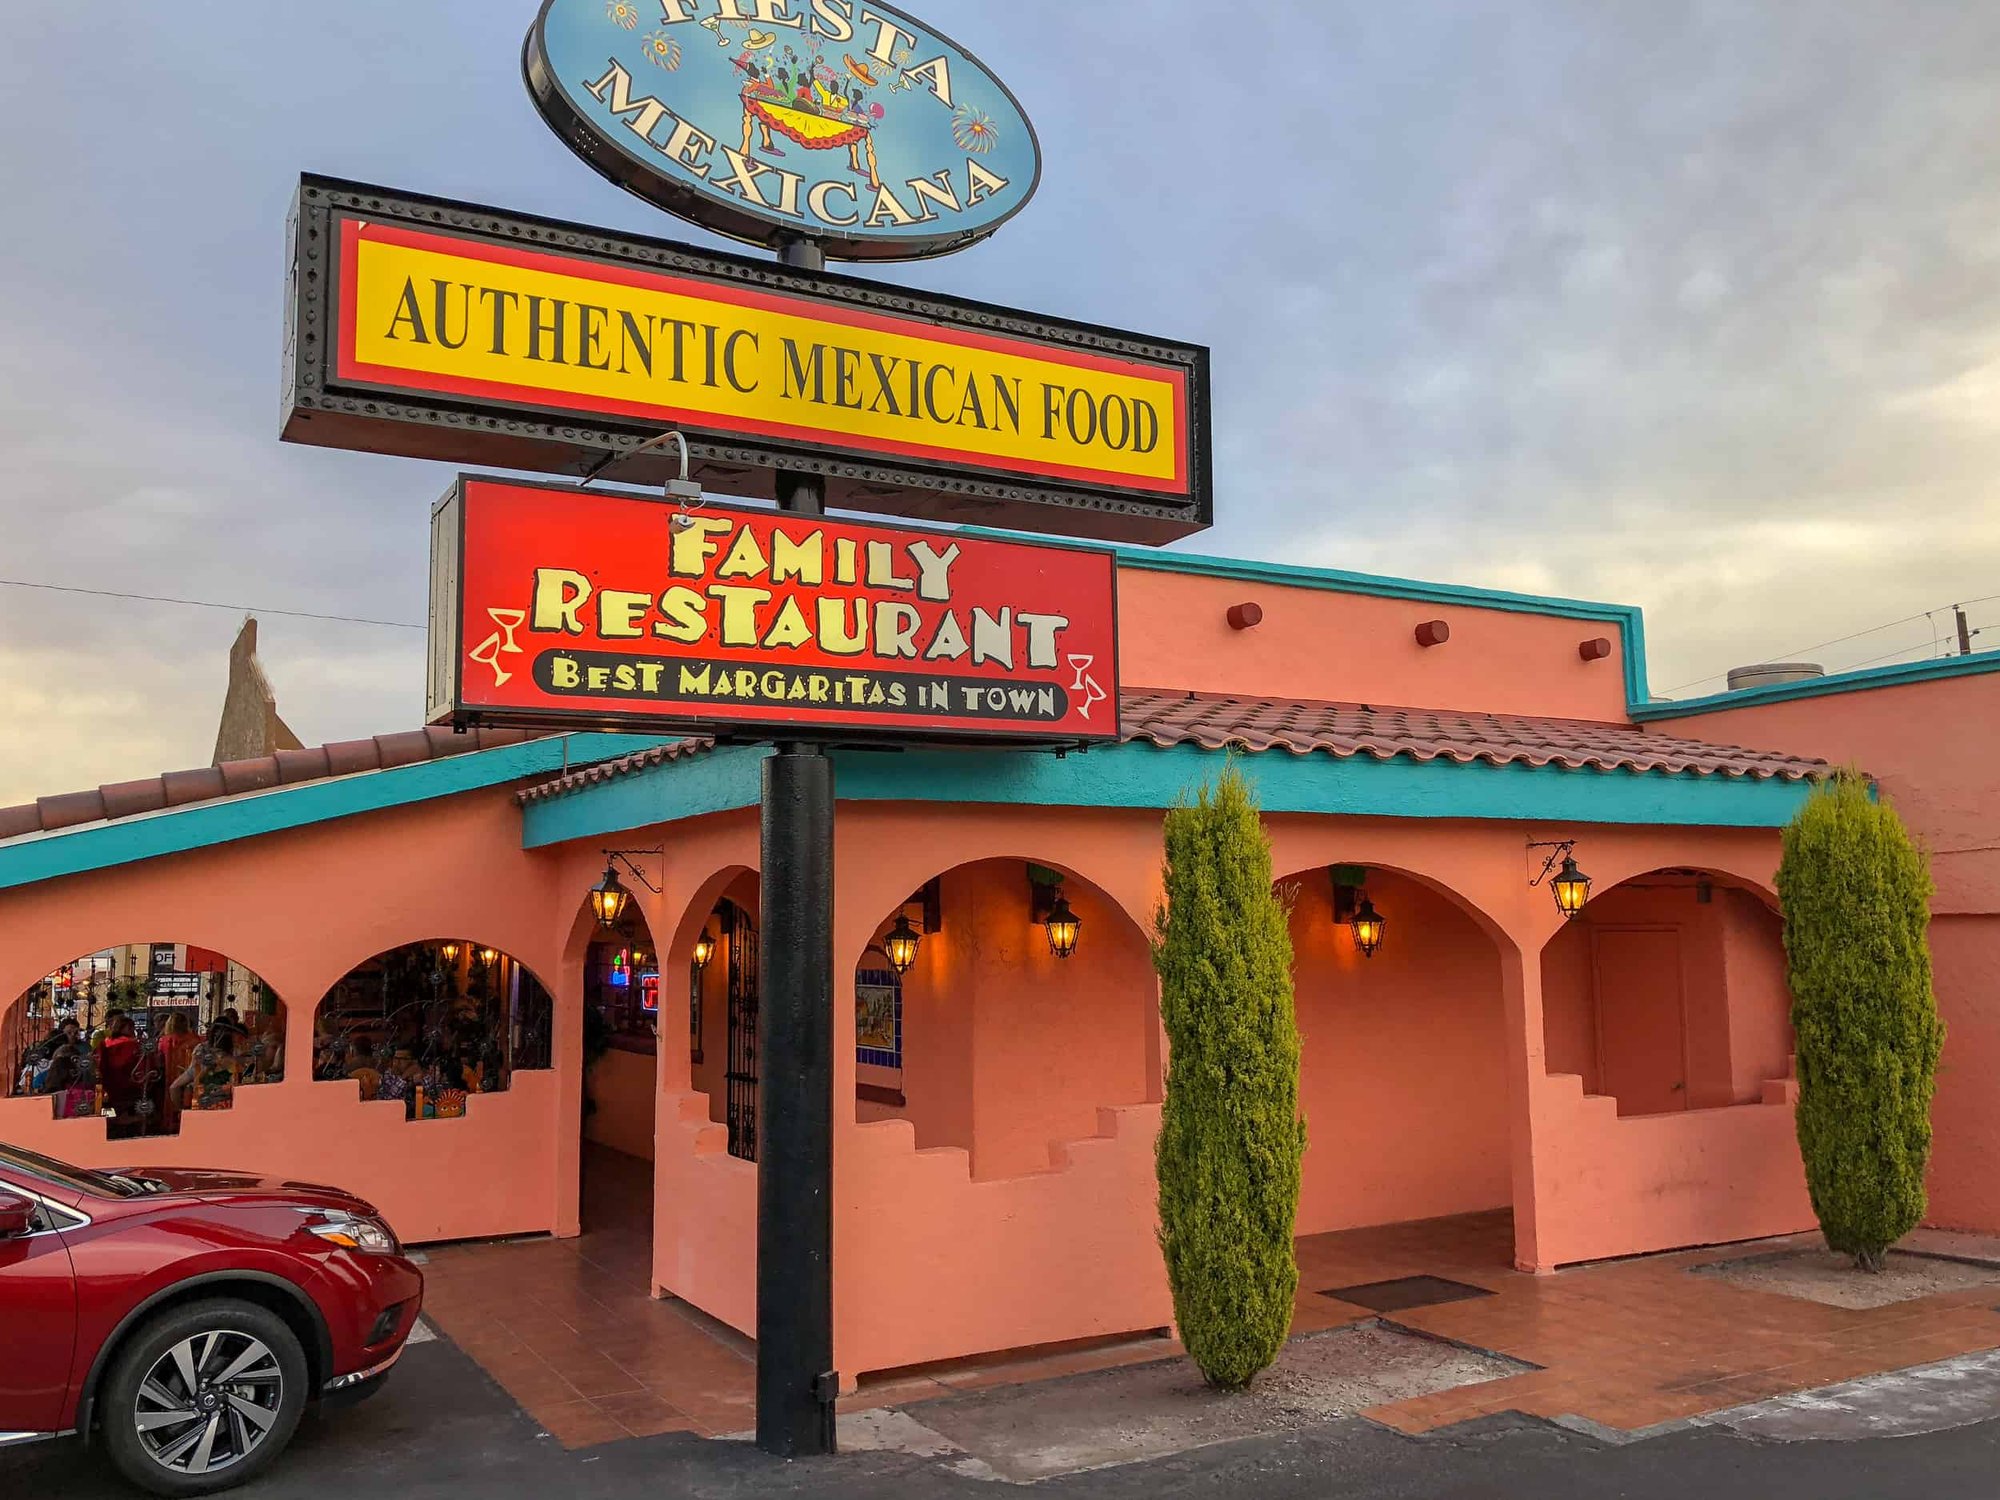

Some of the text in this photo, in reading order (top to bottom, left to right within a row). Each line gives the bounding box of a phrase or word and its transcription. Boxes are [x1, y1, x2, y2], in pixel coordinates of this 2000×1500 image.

[583, 58, 1010, 228] MEXICANA
[384, 275, 1159, 455] AUTHENTIC MEXICAN FOOD
[668, 513, 962, 604] FAMILY
[529, 567, 1070, 671] RESTAURANT
[551, 656, 1055, 717] BEST MARGARITAS IN TOWN
